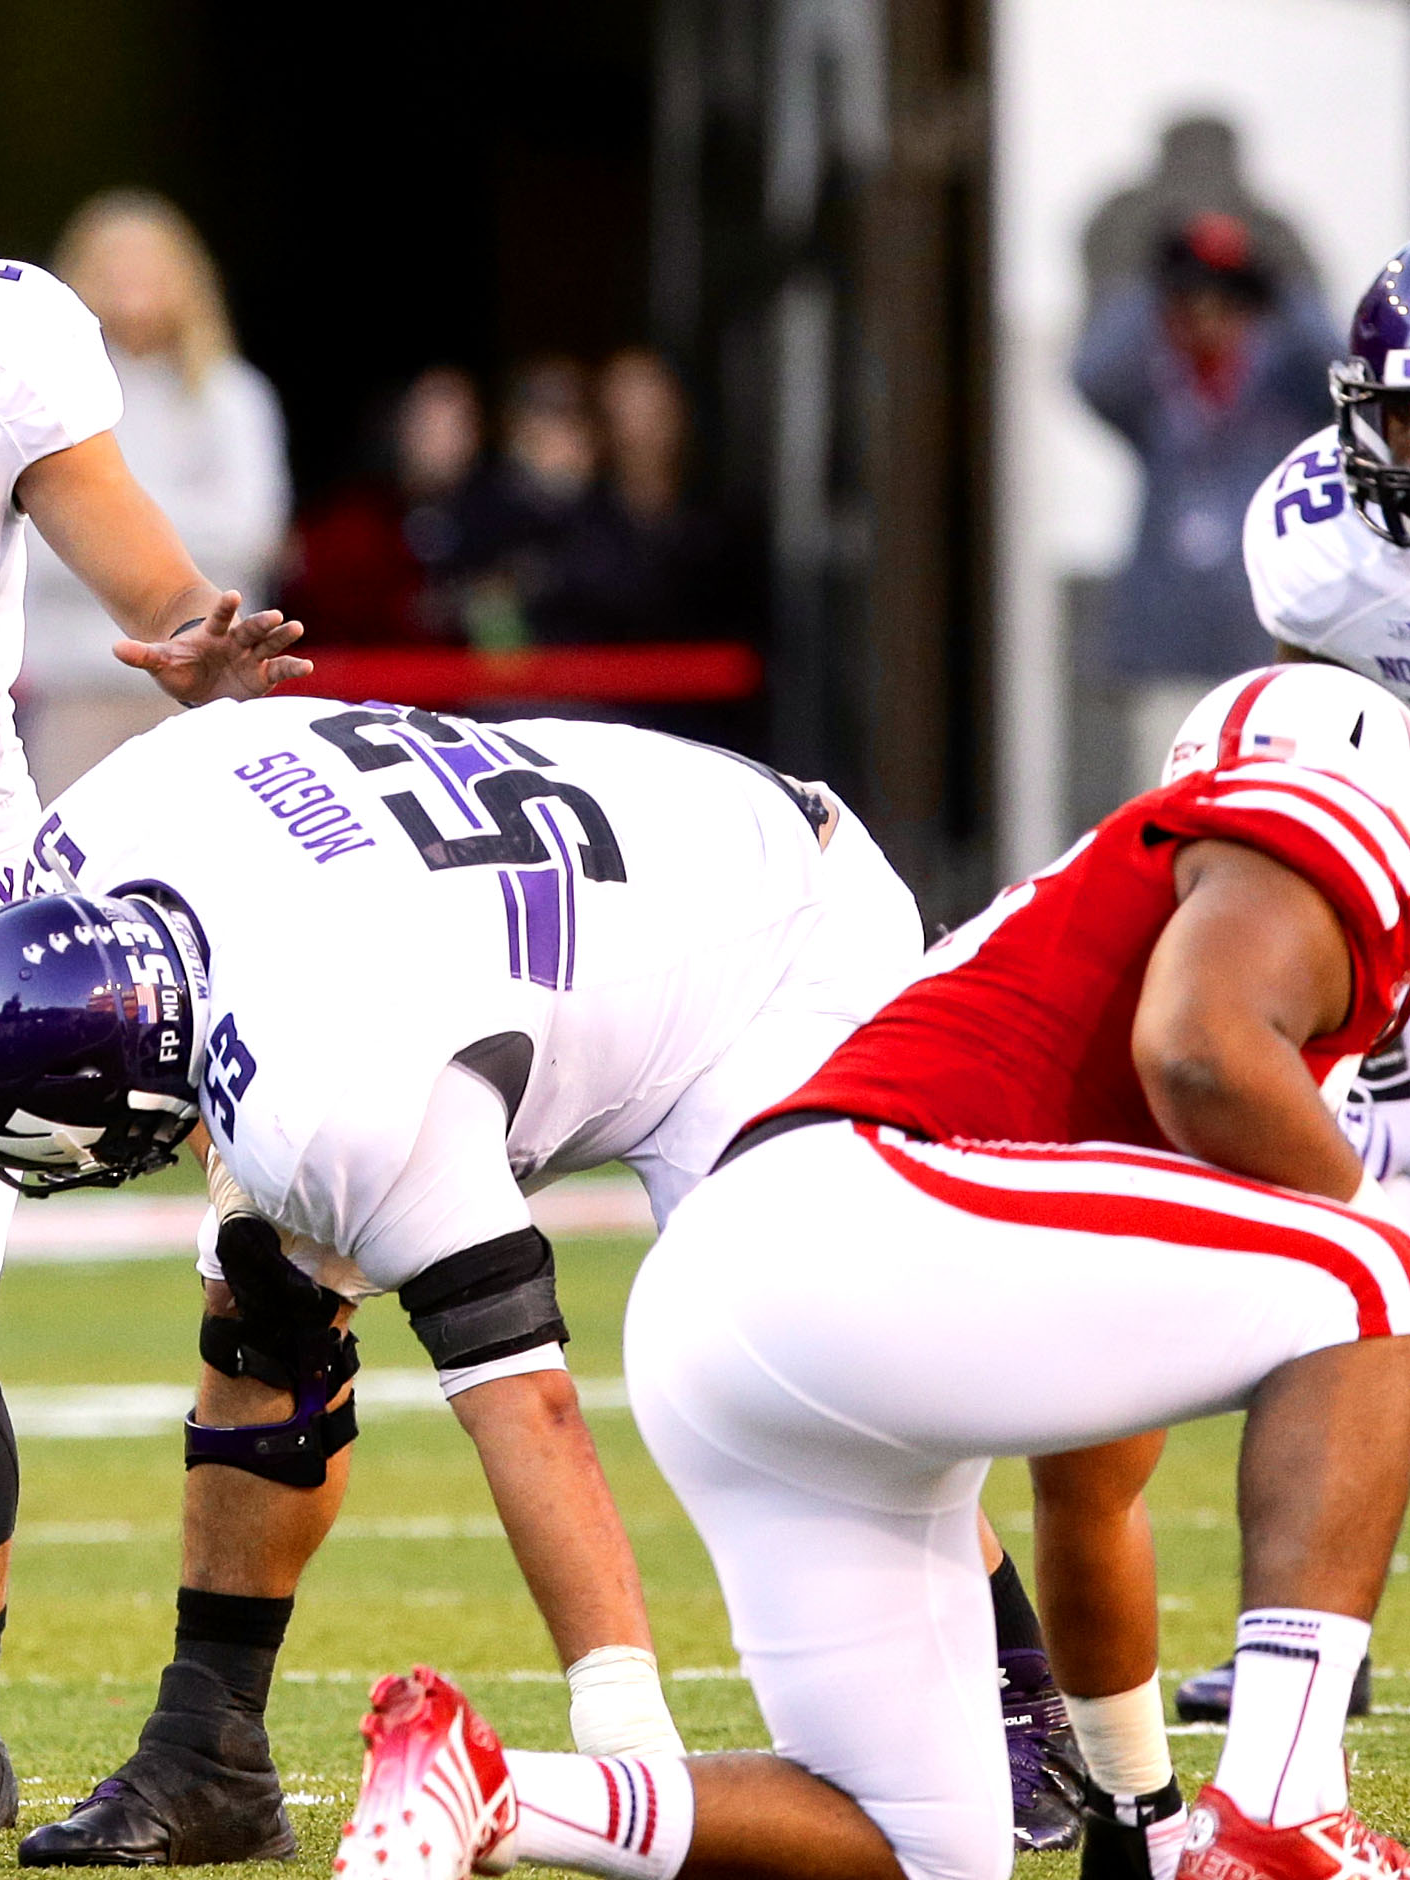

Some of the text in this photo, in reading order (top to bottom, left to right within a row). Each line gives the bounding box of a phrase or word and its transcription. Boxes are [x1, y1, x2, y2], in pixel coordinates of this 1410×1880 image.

[1275, 448, 1344, 538] 22
[233, 751, 377, 864] MOGUS
[309, 704, 628, 883] 53
[111, 920, 176, 987] 53
[159, 1029, 181, 1063] FP
[202, 1011, 258, 1145] 53
